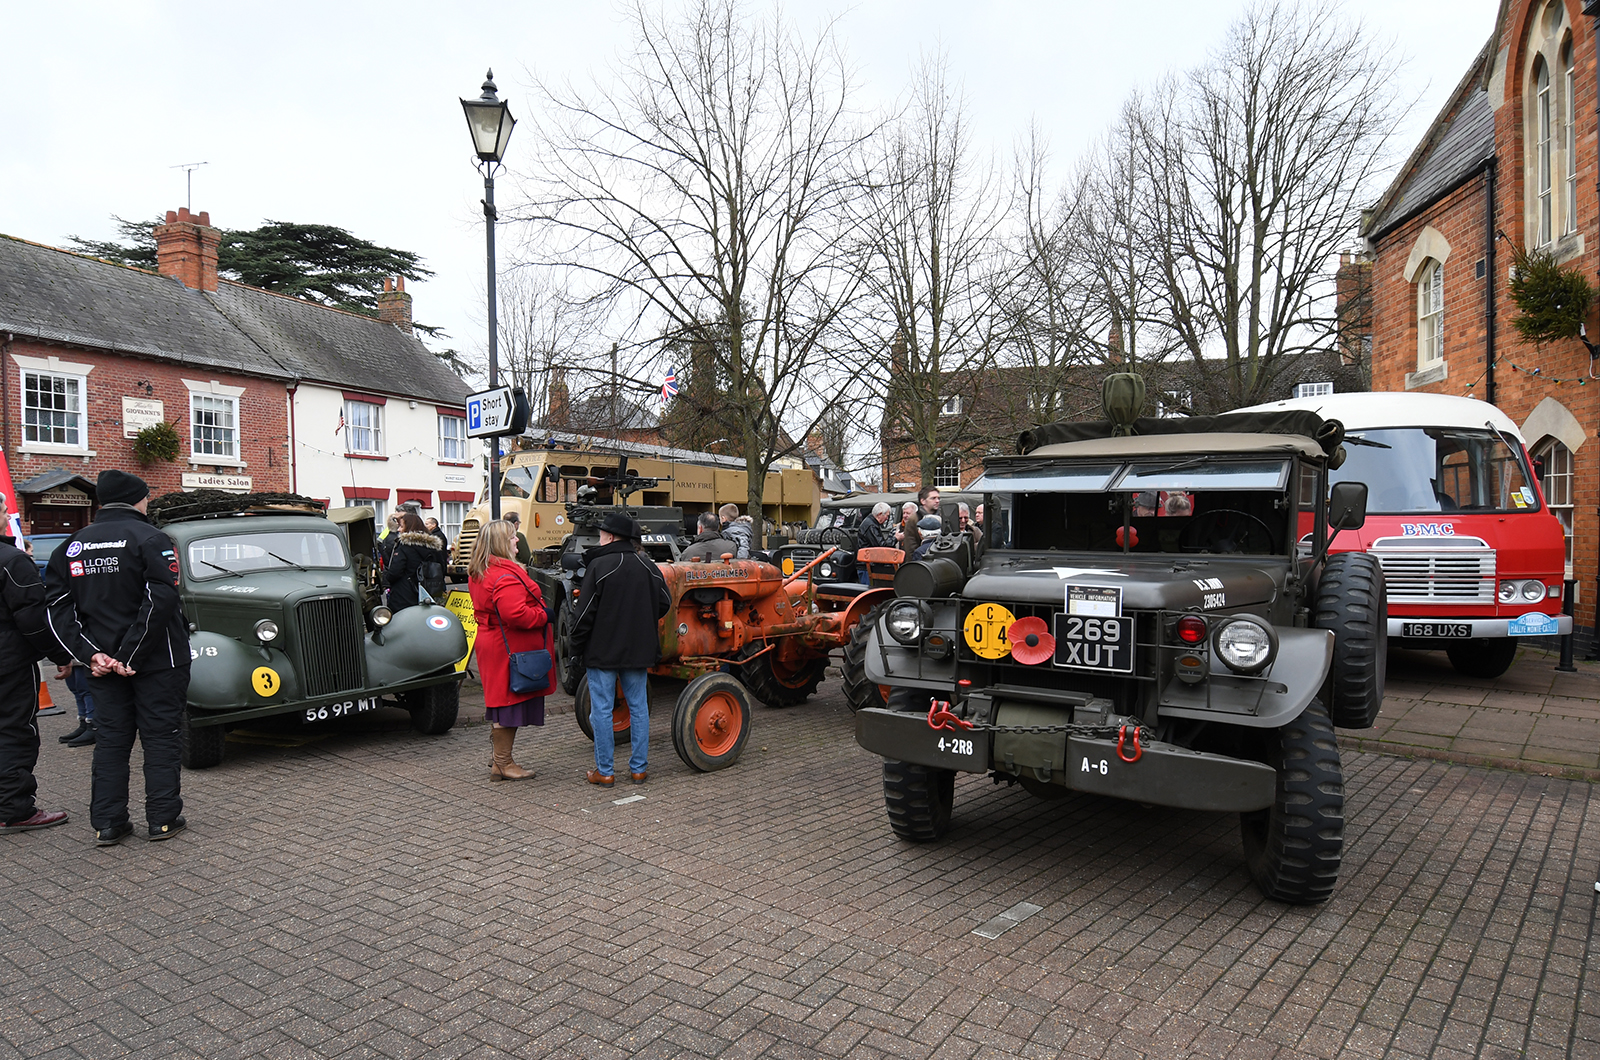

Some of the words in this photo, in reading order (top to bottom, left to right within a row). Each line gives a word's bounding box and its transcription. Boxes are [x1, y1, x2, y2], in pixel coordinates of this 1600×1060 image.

[482, 395, 502, 411] Short
[126, 408, 161, 417] GIOVANNI'S
[471, 403, 480, 427] P
[485, 414, 499, 427] stay
[198, 477, 225, 485] Ladies
[227, 478, 250, 486] Salon
[676, 481, 696, 489] ARMY
[698, 482, 713, 490] FIRE
[641, 534, 654, 542] EA
[83, 540, 127, 551] Kawasaki
[83, 557, 119, 568] LLOYDS
[85, 566, 120, 575] BRITISH
[450, 597, 463, 608] AREA
[463, 599, 474, 610] CLO
[1088, 594, 1117, 602] INFORMATION
[986, 606, 994, 620] C
[1066, 617, 1120, 643] 269
[1408, 624, 1433, 636] 168
[1437, 624, 1468, 637] UXS
[1066, 641, 1120, 668] XUT
[261, 673, 273, 690] 3
[306, 706, 328, 722] 56
[332, 701, 353, 717] 9P
[358, 696, 378, 712] MT
[937, 736, 973, 756] 4-2R8
[1081, 757, 1108, 775] A-6
